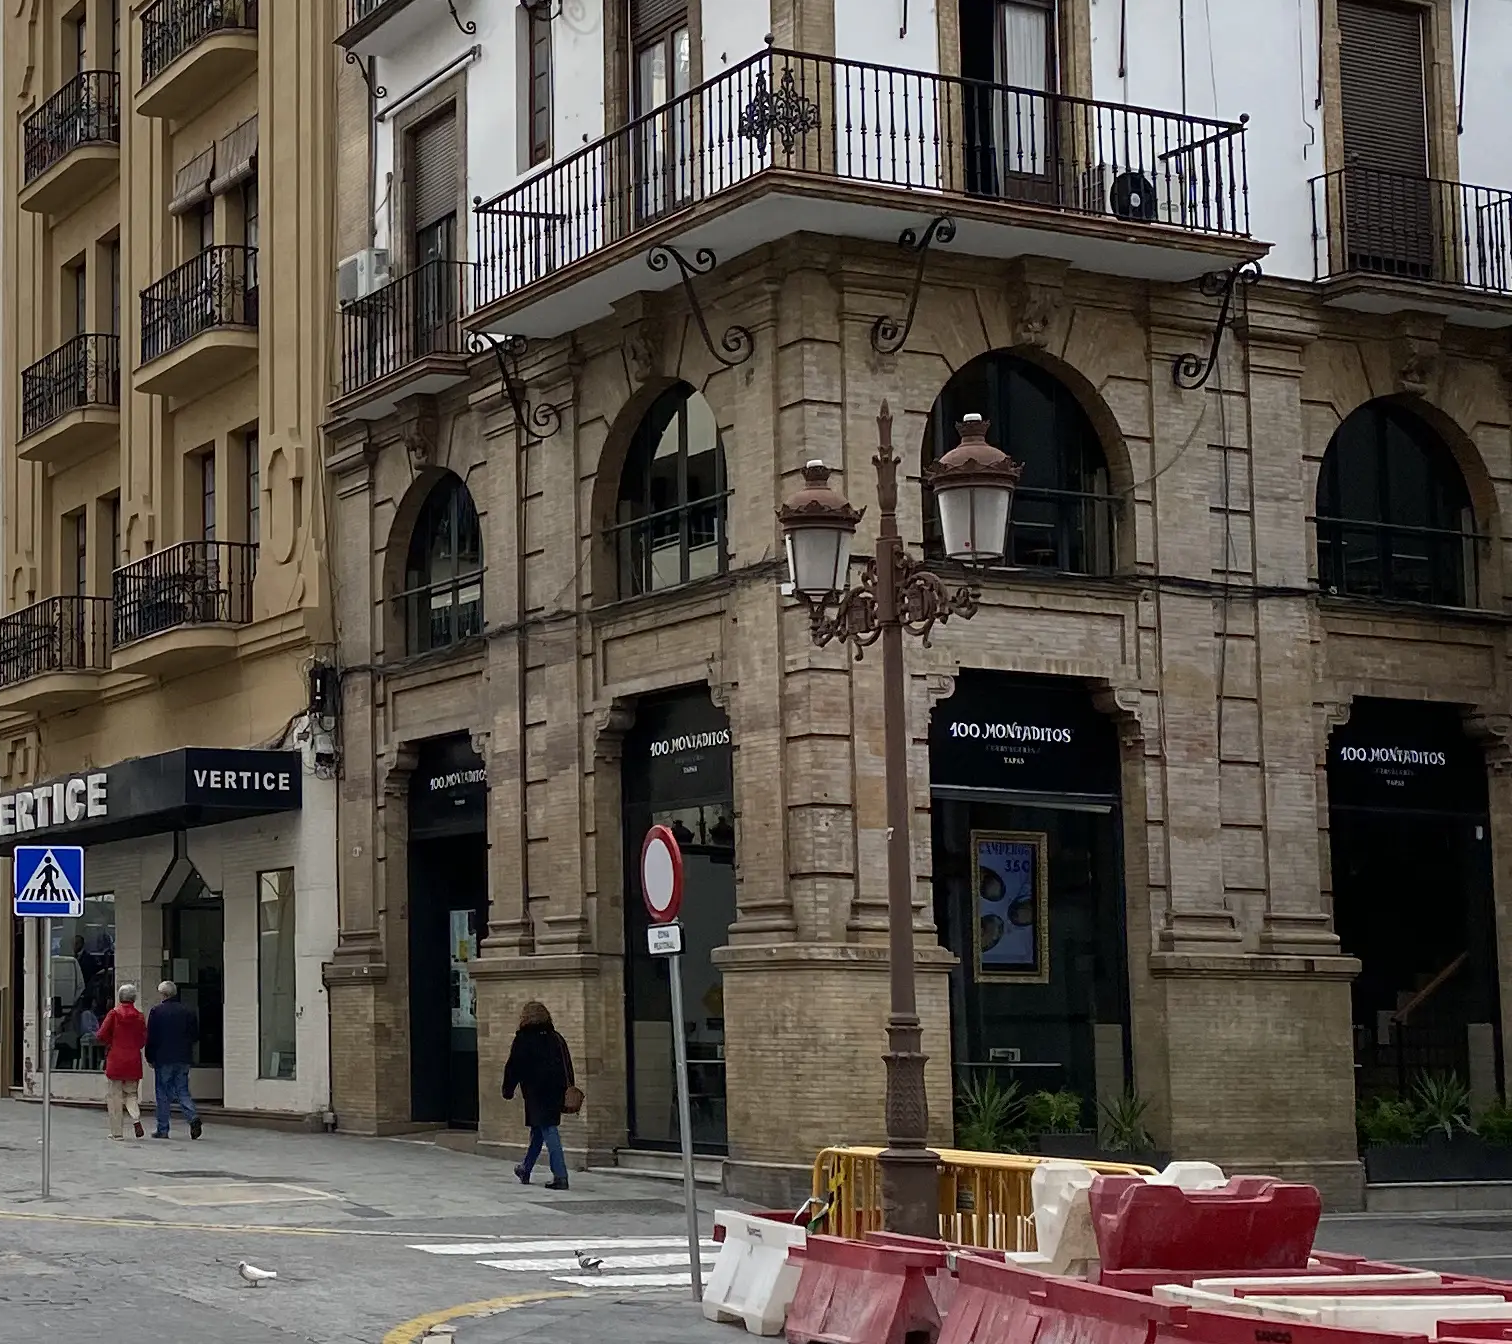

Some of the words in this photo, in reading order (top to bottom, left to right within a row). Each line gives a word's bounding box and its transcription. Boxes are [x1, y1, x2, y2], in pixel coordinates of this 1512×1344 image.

[949, 722, 981, 738] 100
[981, 721, 1072, 743] MONTADITOS
[650, 740, 669, 757] 100
[1340, 746, 1367, 762] 100
[1368, 746, 1446, 766] MONTADITOS
[193, 769, 290, 791] VERTICE
